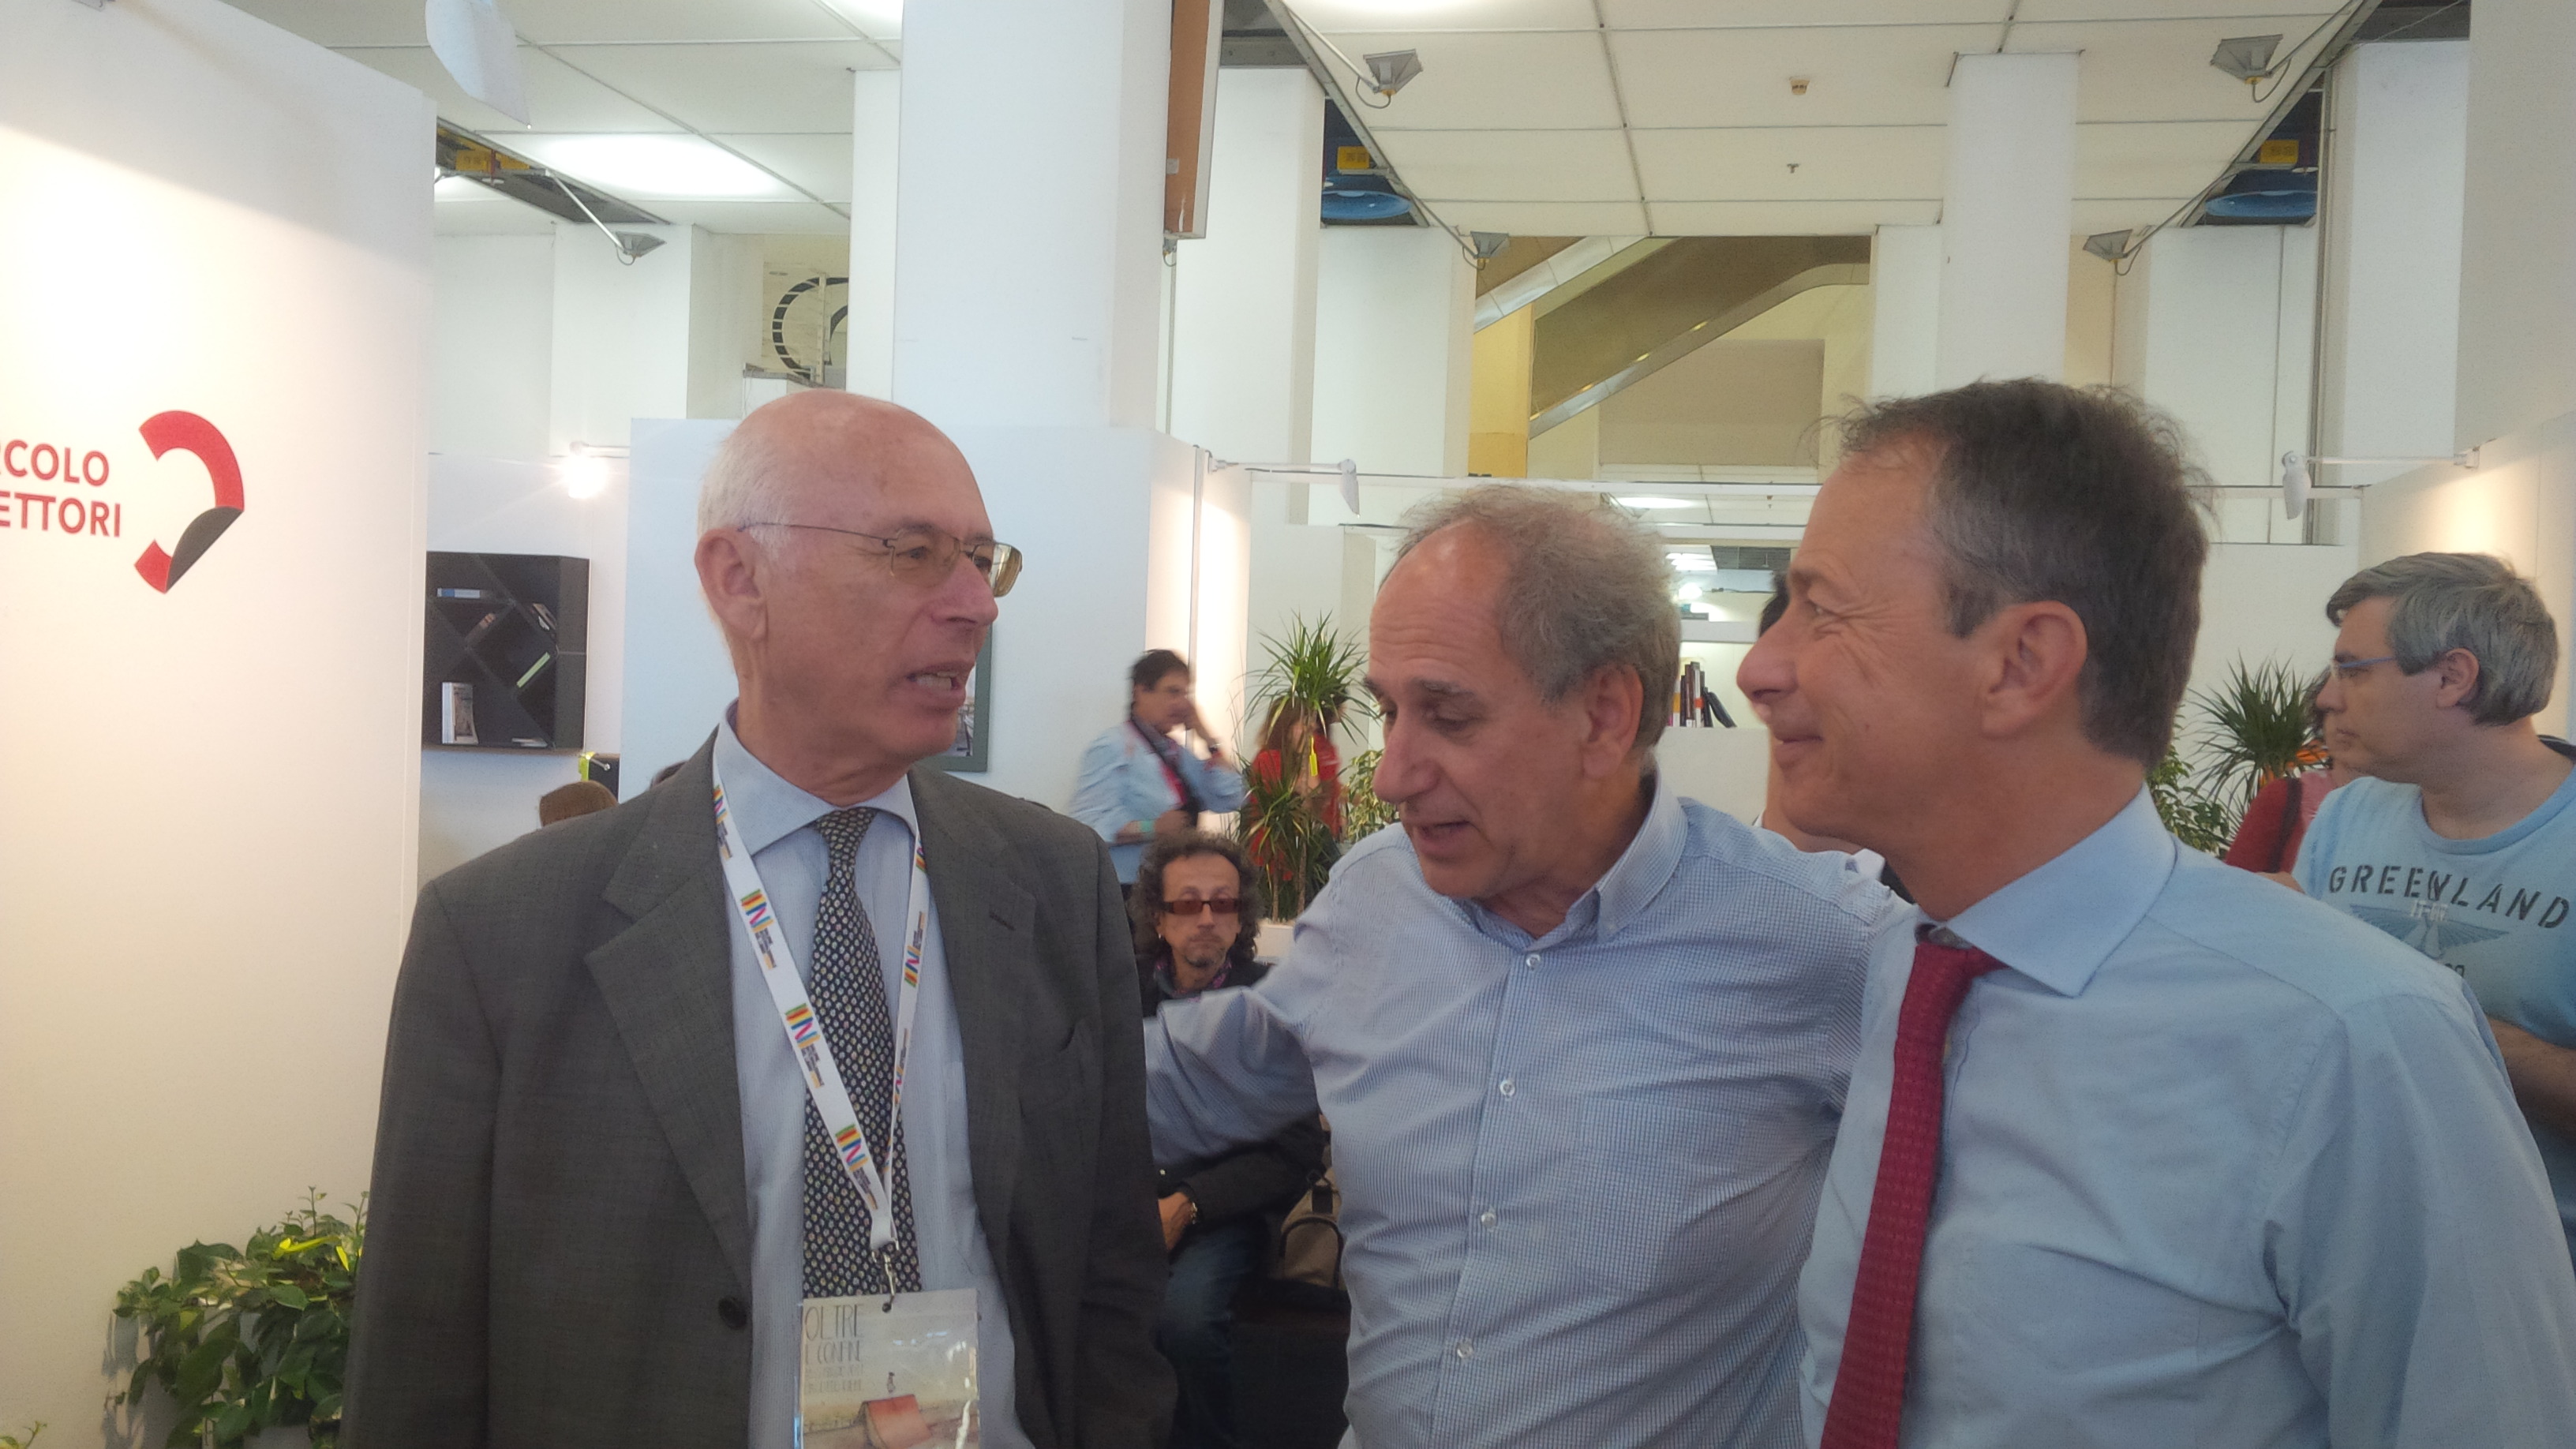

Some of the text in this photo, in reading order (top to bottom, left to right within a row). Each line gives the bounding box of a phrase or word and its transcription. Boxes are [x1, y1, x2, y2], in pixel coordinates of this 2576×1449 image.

[0, 439, 110, 487] COLO
[2328, 865, 2570, 929] GREENLAND
[804, 1304, 865, 1342] OLTRE
